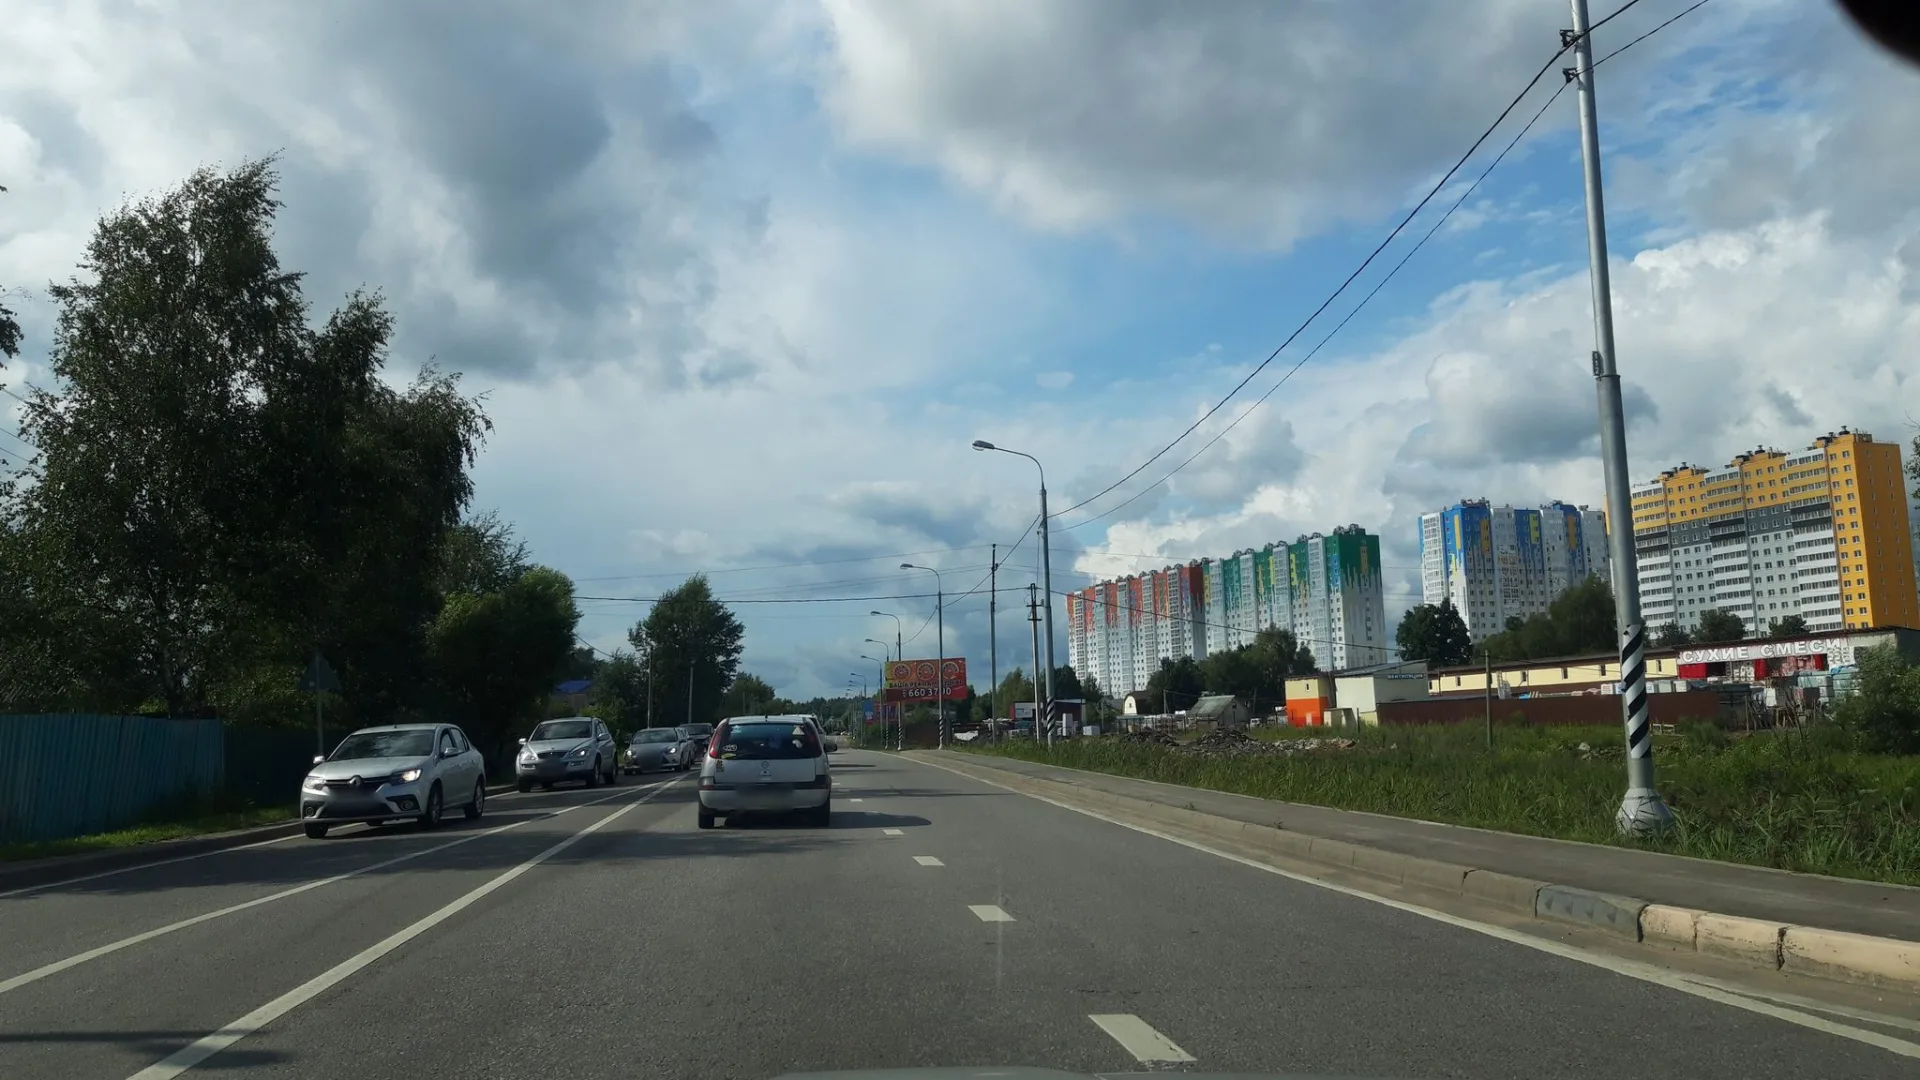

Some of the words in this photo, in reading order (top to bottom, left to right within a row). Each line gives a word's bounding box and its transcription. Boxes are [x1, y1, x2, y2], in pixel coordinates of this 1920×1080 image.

[1682, 647, 1748, 662] СУХИЕ
[1760, 638, 1840, 656] СМЕСИ
[908, 688, 925, 697] 660
